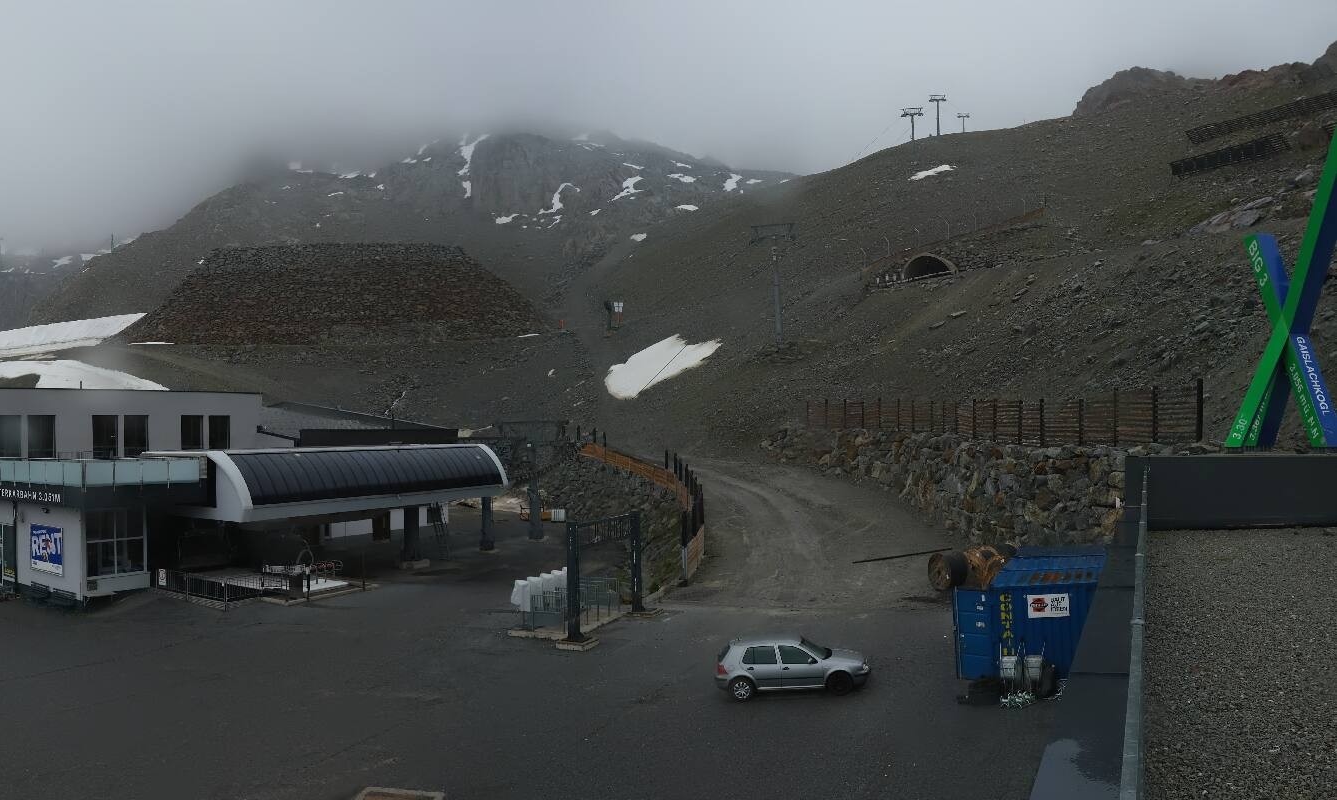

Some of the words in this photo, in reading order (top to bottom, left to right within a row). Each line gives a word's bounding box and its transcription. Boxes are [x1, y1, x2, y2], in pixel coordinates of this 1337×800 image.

[1248, 240, 1263, 272] BIG
[1259, 273, 1268, 286] 3
[1296, 336, 1331, 416] GAISLACHKOGL
[31, 532, 62, 557] RENT
